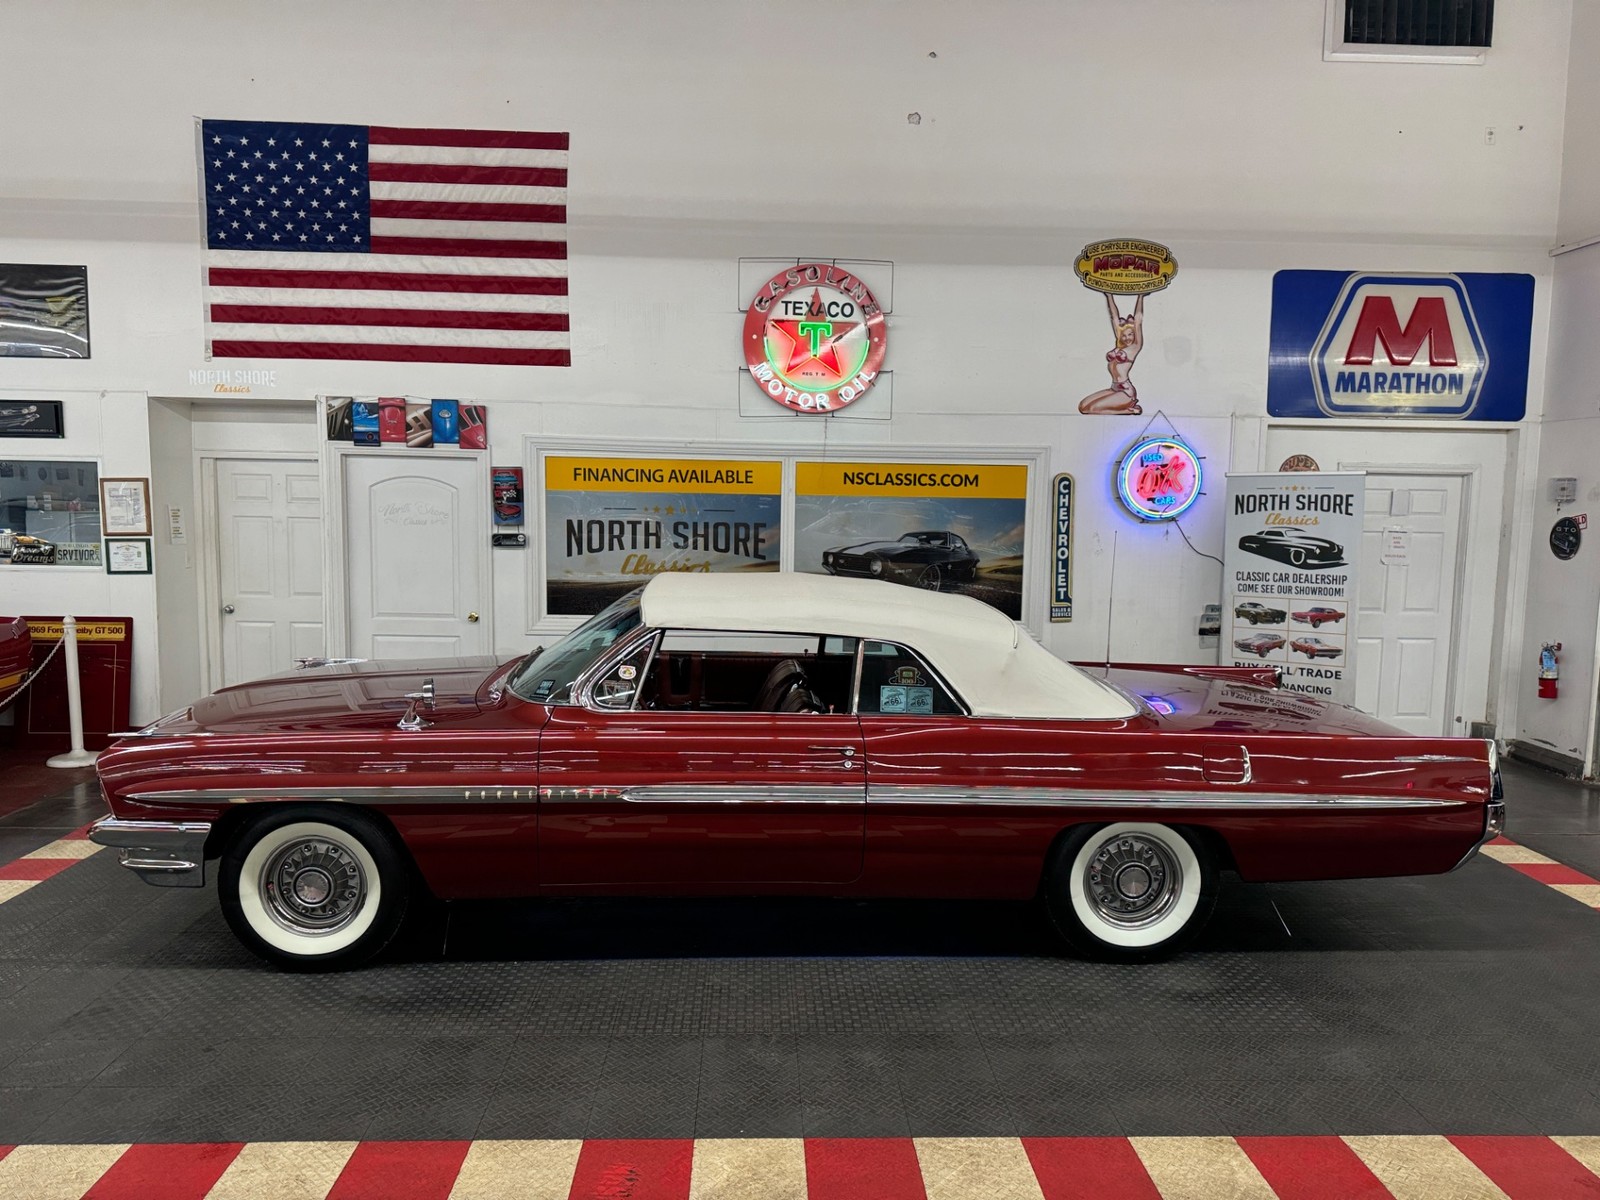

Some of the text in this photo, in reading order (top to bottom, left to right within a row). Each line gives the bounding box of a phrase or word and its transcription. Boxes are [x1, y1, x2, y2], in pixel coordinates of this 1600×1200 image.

[754, 266, 881, 318] GASOLINE
[781, 300, 854, 318] TEXACO
[1344, 296, 1458, 367] M
[188, 369, 277, 387] NORTH SHORE
[754, 362, 876, 411] MOTOR OIL
[1335, 372, 1464, 395] MARATHON
[213, 383, 251, 393] Classics
[573, 467, 754, 484] FINANCING AVAILABLE
[843, 471, 979, 487] NSCLASSICS.COM
[1235, 494, 1354, 516] NORTH SHORE
[1264, 513, 1319, 526] Classics
[566, 519, 767, 560] NORTH SHORE
[1057, 481, 1070, 600] CHEVROLET
[1236, 571, 1348, 585] CLASSIC CAR DEALERSHIP
[1237, 583, 1345, 597] COME SEE OUR SHOWROOM!
